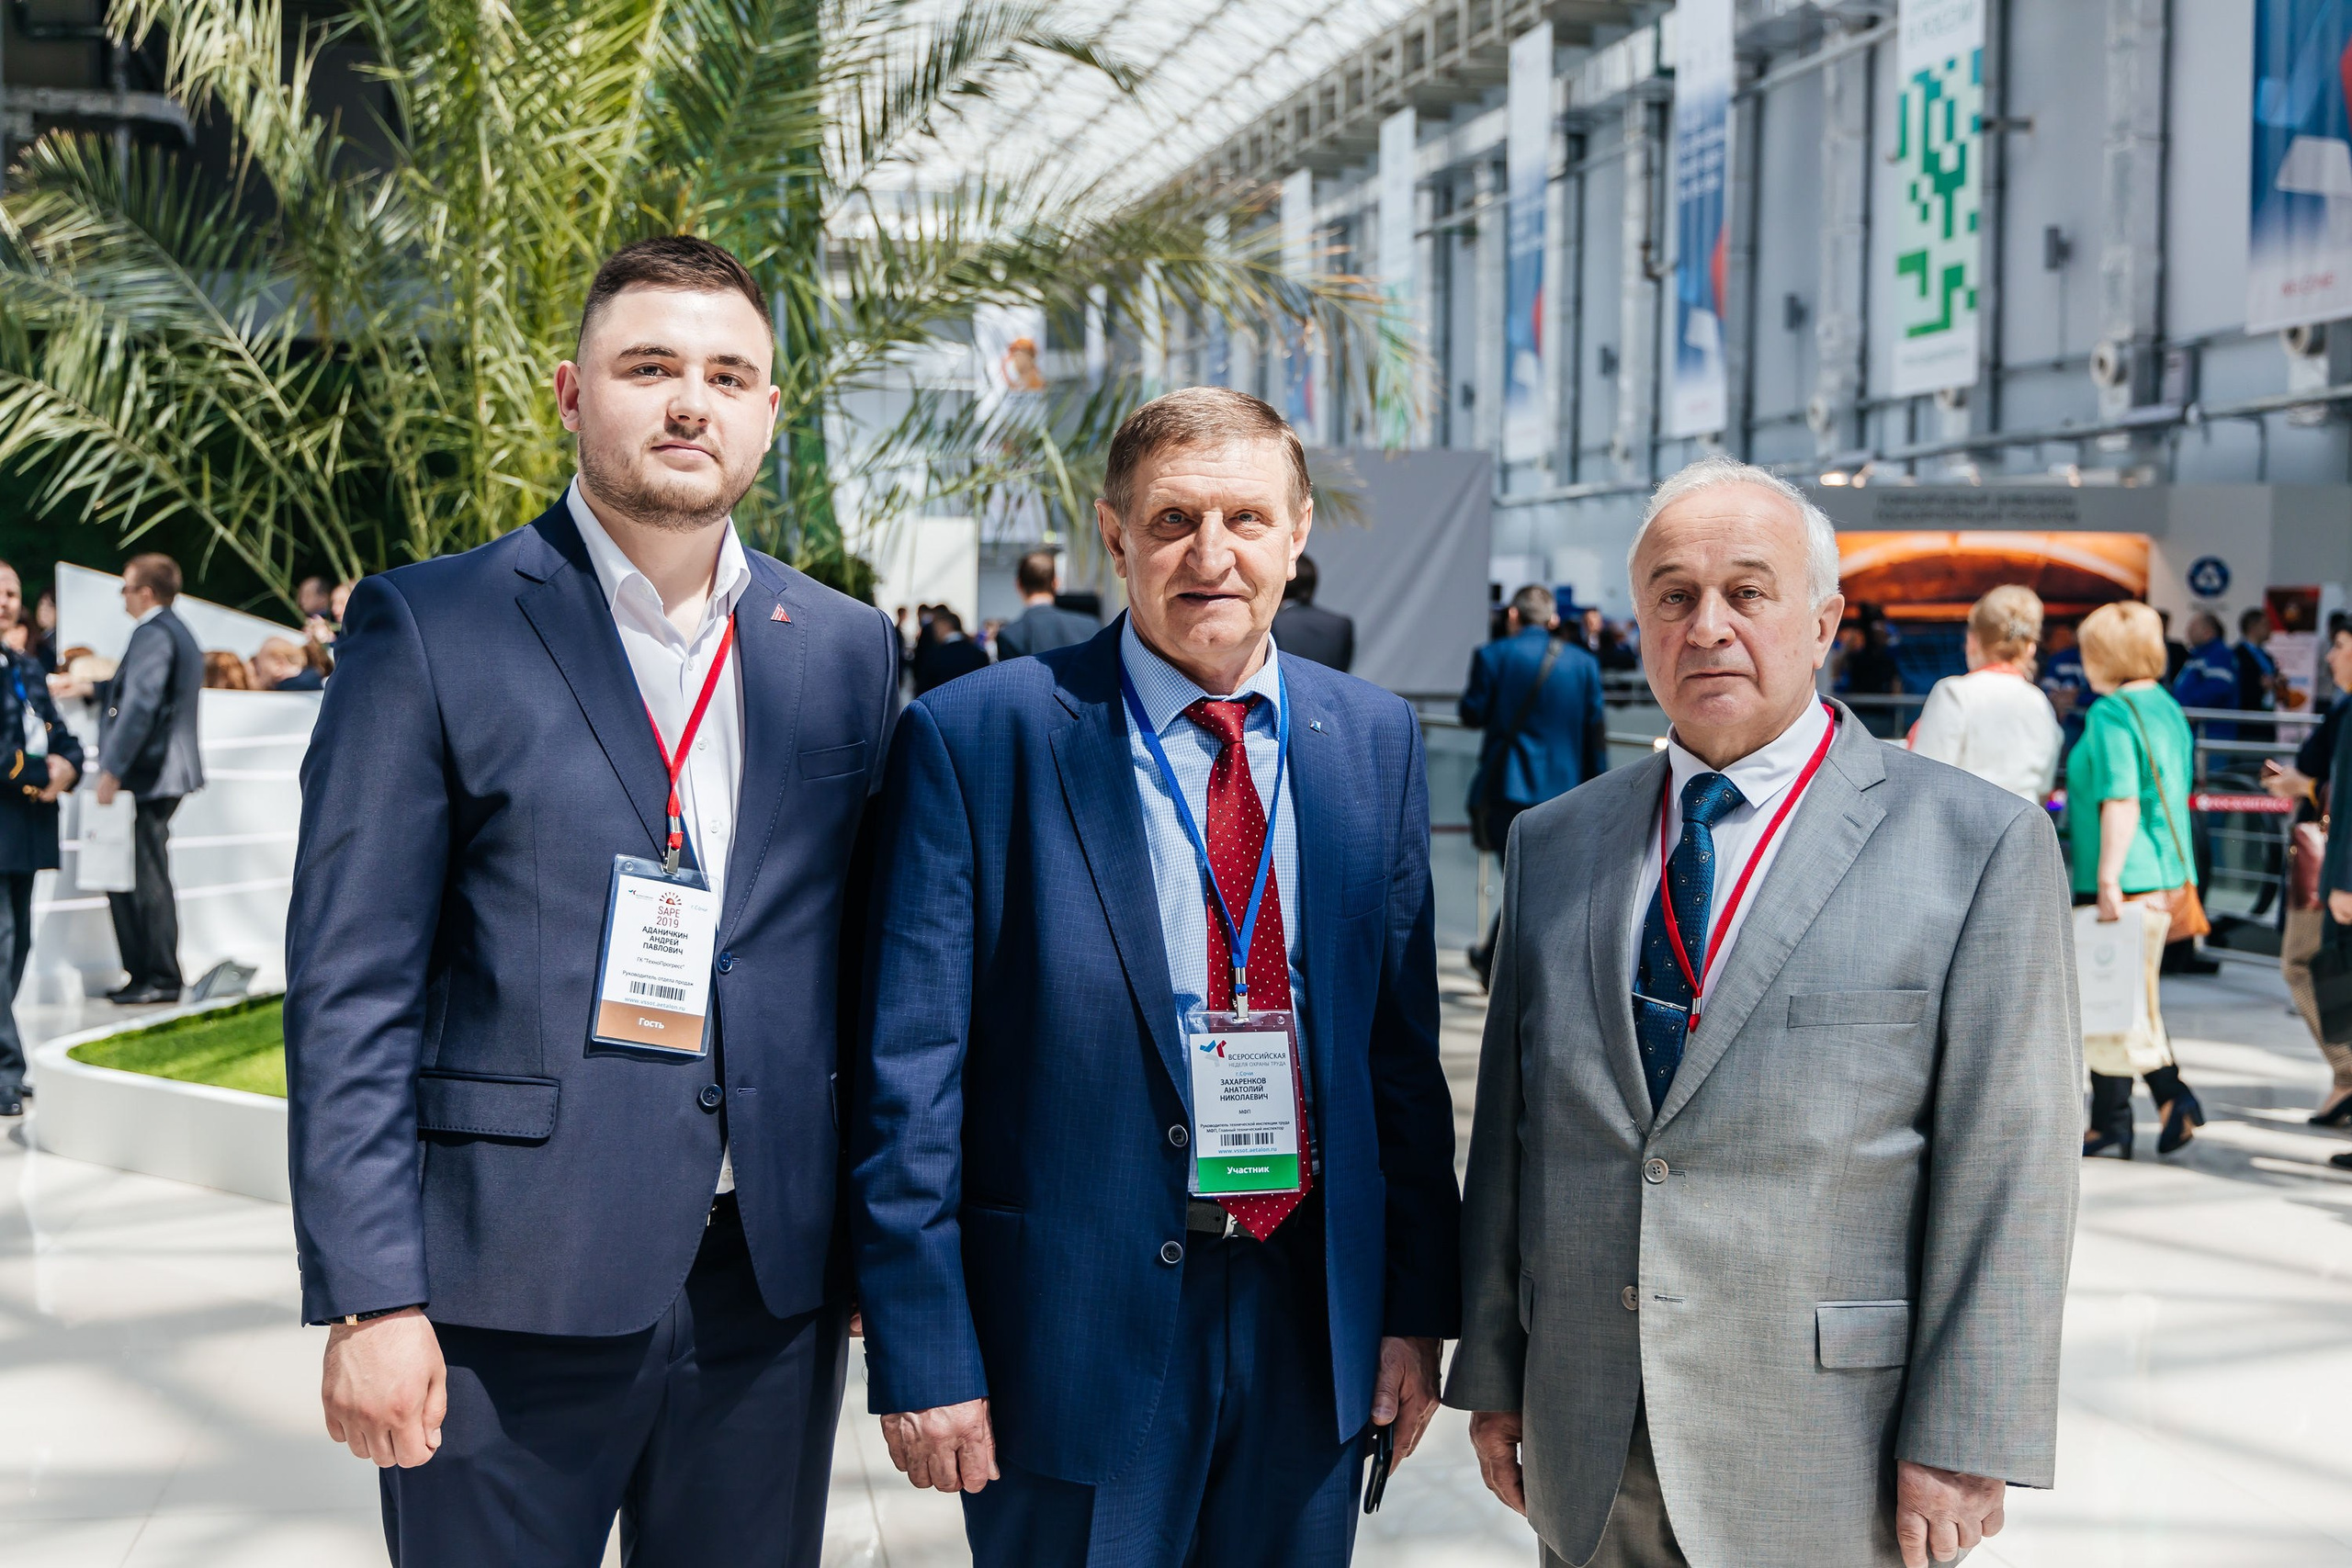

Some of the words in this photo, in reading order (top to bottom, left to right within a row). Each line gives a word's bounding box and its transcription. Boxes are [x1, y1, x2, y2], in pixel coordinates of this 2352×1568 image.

[658, 906, 680, 918] SAPE
[657, 917, 679, 928] 2019
[642, 926, 688, 939] АДАНИЧКИН
[650, 936, 679, 946] АНДРЕЙ
[643, 942, 683, 955] ПАВЛОВИЧ
[623, 970, 657, 980] Руководитель
[639, 1017, 665, 1029] Гость
[1228, 1052, 1286, 1060] ВСЕРОССИЙСКАЯ
[1224, 1084, 1264, 1093] АНАТОЛИЙ
[1227, 1166, 1269, 1174] Участник
